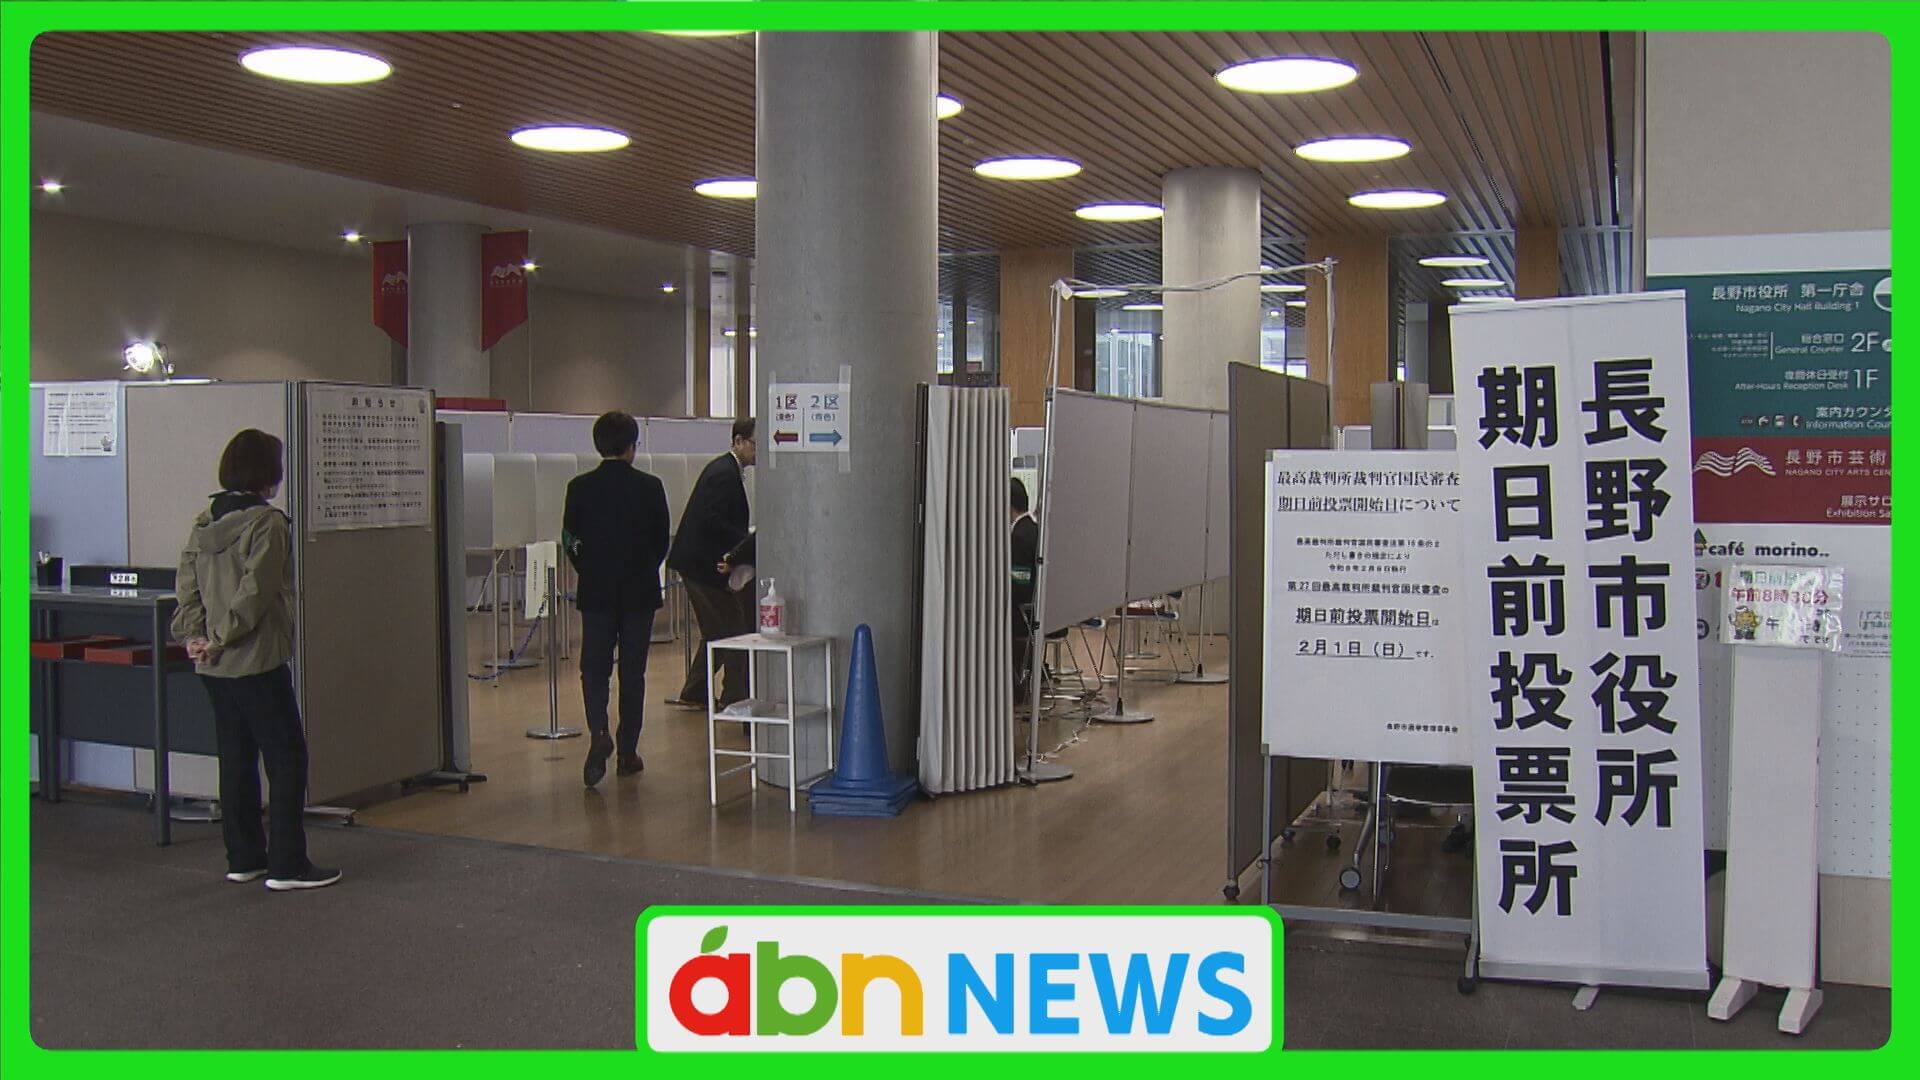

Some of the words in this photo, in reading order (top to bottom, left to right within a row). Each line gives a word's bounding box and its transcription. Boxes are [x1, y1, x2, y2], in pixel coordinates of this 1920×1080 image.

[1712, 284, 1789, 300] 長野市役所
[1801, 283, 1865, 298] 第一庁舎
[1736, 304, 1772, 314] Nagano
[1774, 303, 1792, 314] City
[1794, 303, 1814, 312] Hall
[1815, 301, 1852, 312] Building
[1775, 345, 1809, 354] General
[1812, 345, 1845, 353] Counter
[1801, 333, 1845, 344] 総合窓口
[1851, 332, 1880, 353] 2F
[1735, 383, 1781, 391] After-Hours
[1784, 382, 1824, 391] Reception
[1827, 381, 1849, 390] Desk
[1853, 369, 1879, 389] 1F
[776, 393, 798, 410] 1区
[810, 393, 840, 410] 2区
[1806, 421, 1864, 430] Information
[1785, 449, 1888, 466] 長野市芸術
[1277, 471, 1461, 487] 最高裁判所裁判官国民審査
[1277, 496, 1461, 513] 期日前投票開始日について
[1826, 507, 1876, 518] Exhibition
[1708, 541, 1745, 557] café
[1581, 357, 1681, 828] 長野市役所
[1477, 364, 1579, 917] 期日前投票所
